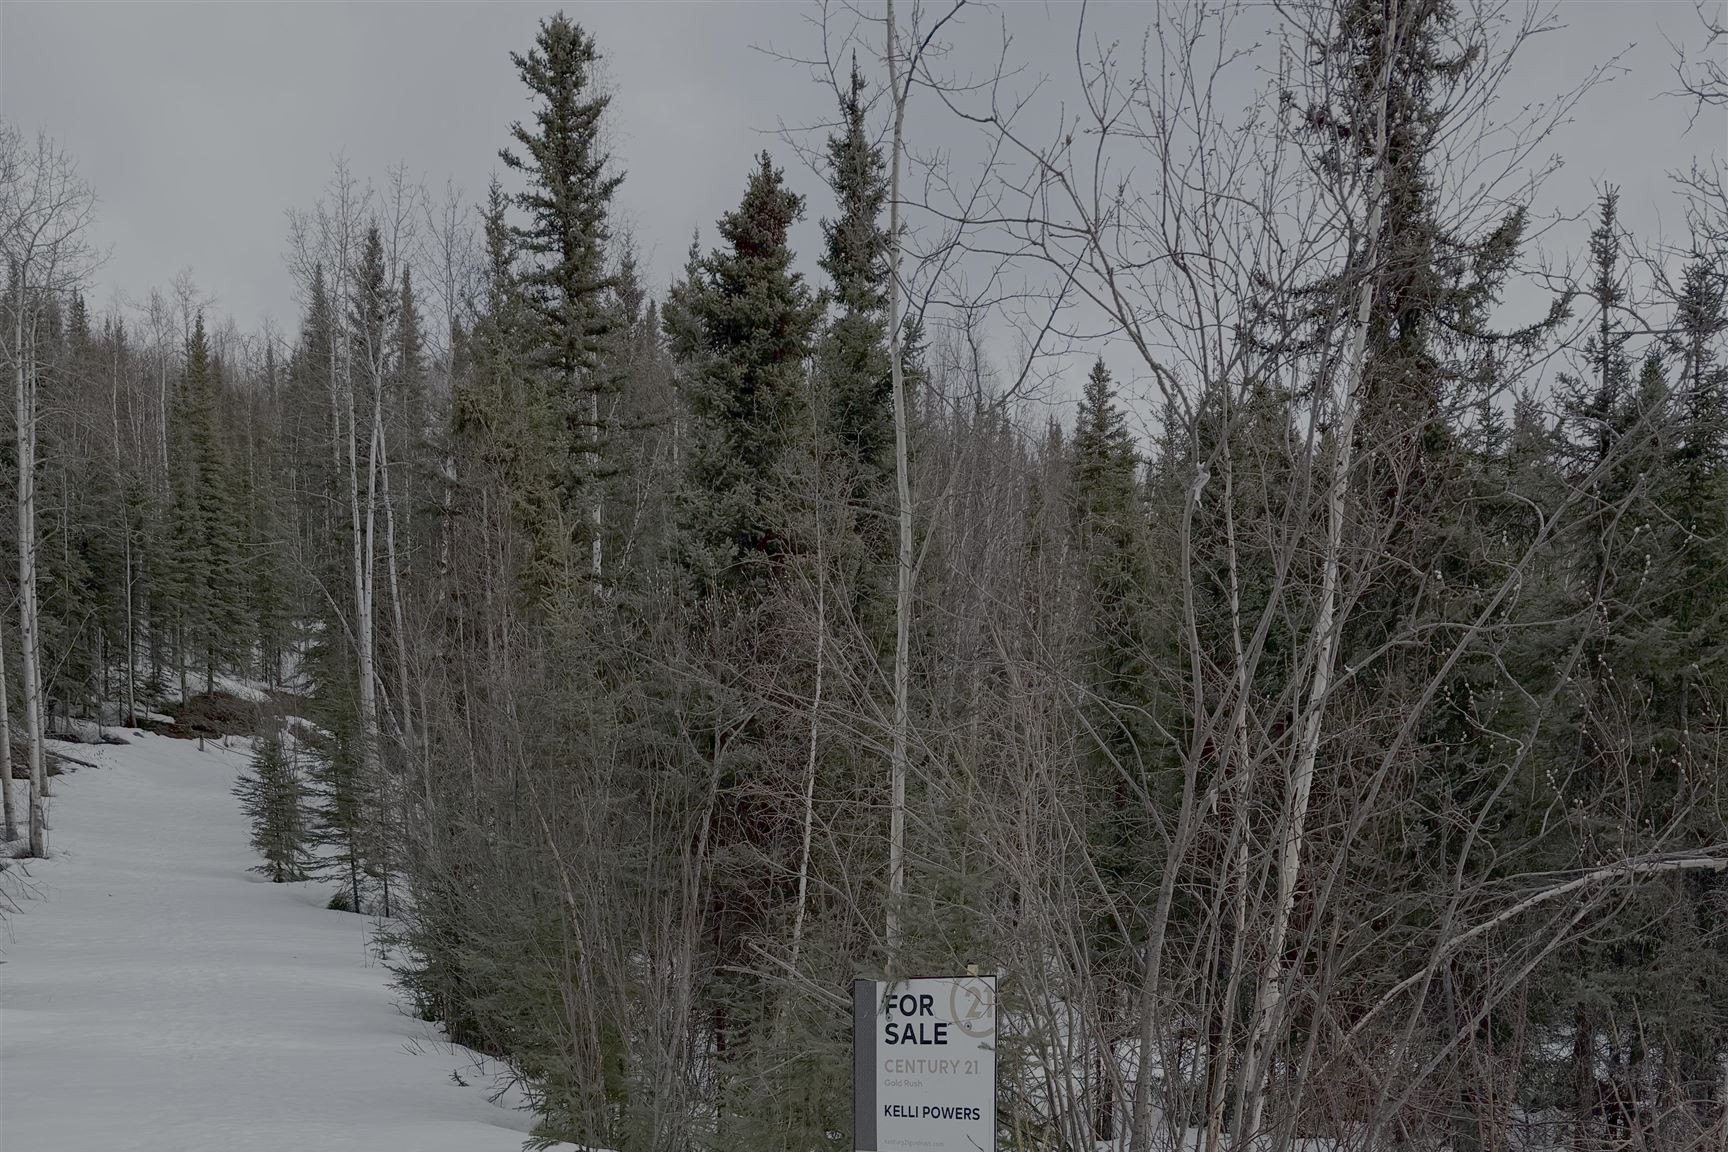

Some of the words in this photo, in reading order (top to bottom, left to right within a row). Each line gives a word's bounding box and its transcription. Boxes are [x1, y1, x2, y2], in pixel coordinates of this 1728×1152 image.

[886, 994, 934, 1016] FOR
[965, 986, 992, 1018] 21
[885, 1023, 948, 1045] SALE
[884, 1059, 960, 1074] CENTURY
[965, 1060, 979, 1075] 21
[884, 1079, 902, 1088] Gold
[904, 1079, 923, 1088] Rush
[884, 1104, 919, 1118] KELLI
[922, 1106, 980, 1120] POWERS
